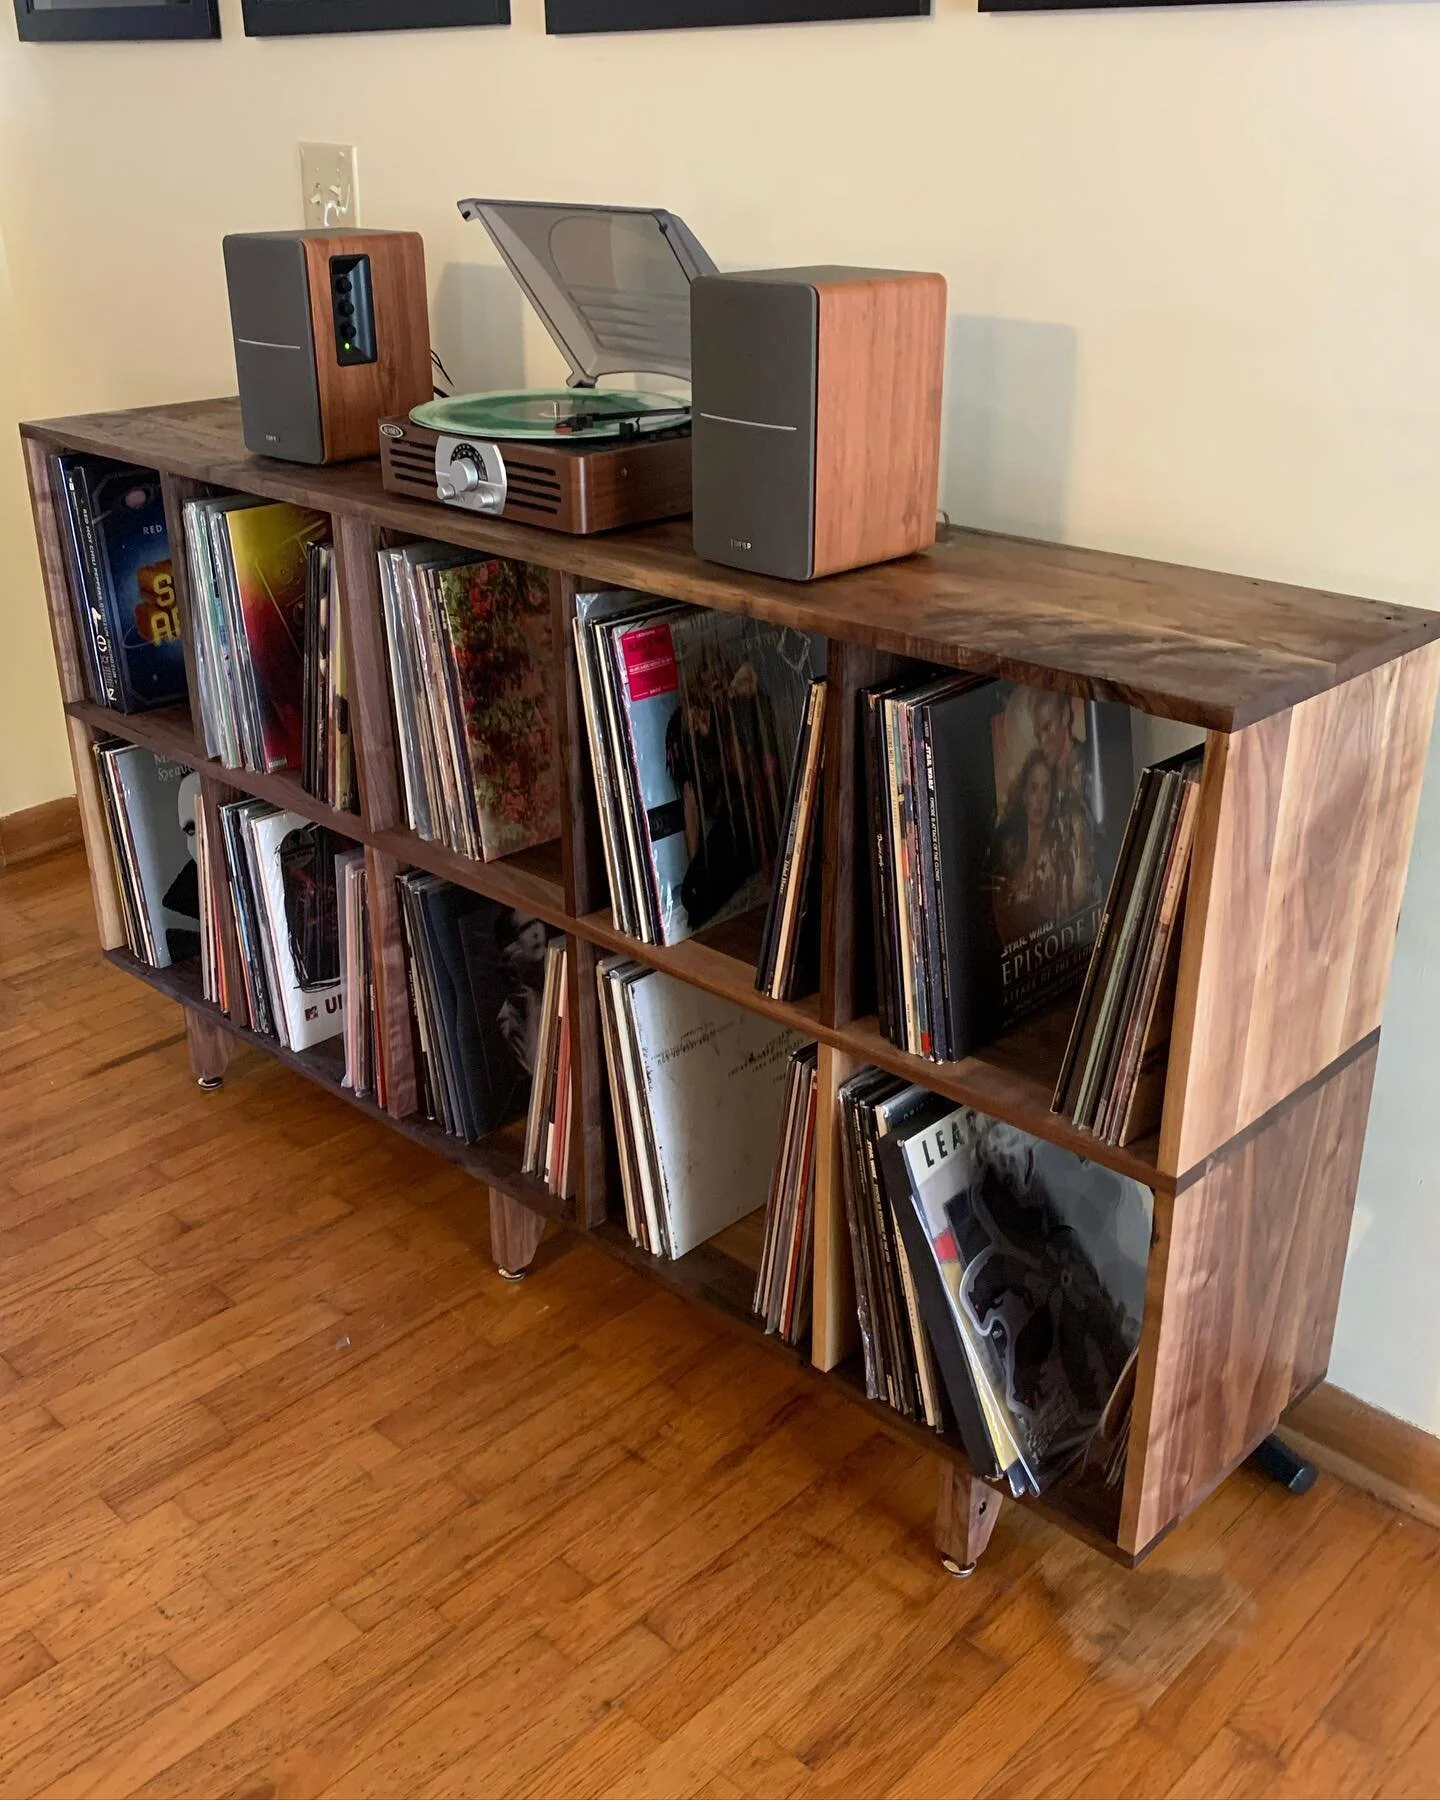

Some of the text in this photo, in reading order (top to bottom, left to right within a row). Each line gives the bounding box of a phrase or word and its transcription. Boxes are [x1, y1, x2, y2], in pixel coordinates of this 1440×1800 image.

[143, 525, 162, 535] RED
[93, 567, 102, 600] PEPPERS
[924, 742, 932, 766] STAR
[926, 766, 934, 790] WARS
[1001, 921, 1055, 959] STAR WARS
[1002, 918, 1085, 986] EPISODE
